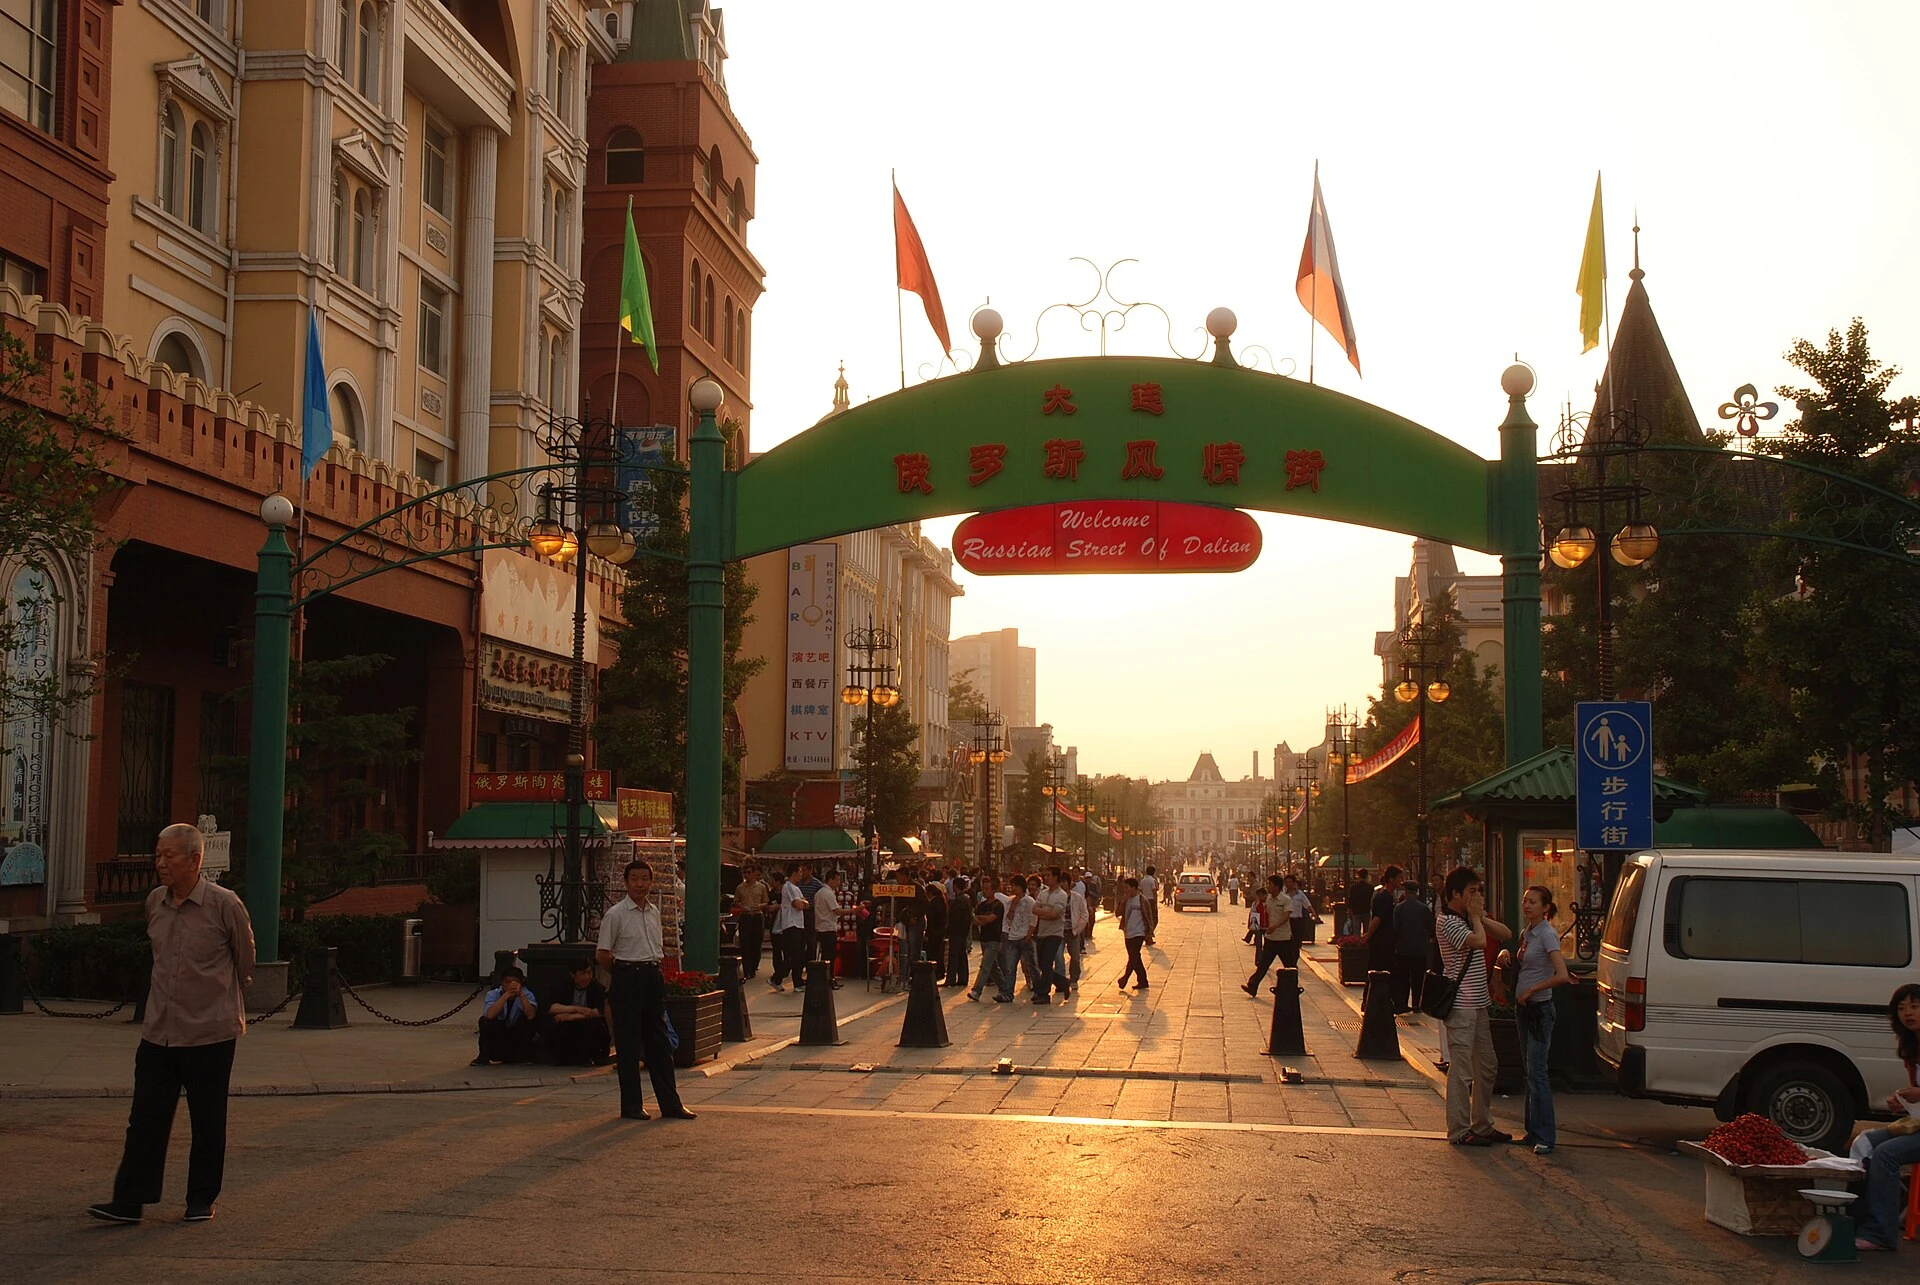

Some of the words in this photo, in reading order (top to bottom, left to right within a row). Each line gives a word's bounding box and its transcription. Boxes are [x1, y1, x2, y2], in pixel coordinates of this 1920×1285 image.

[892, 438, 1327, 494] 俄罗斯风情街
[1059, 509, 1151, 529] Welcome
[961, 538, 1053, 560] Russian
[1065, 540, 1127, 558] Street
[1140, 537, 1169, 561] Of
[1183, 536, 1252, 555] Dalian
[792, 652, 830, 662] 演艺吧
[792, 678, 830, 689] 西餐厅
[791, 704, 829, 716] 棋牌室
[790, 731, 828, 741] KTV
[1601, 776, 1629, 846] 步行街
